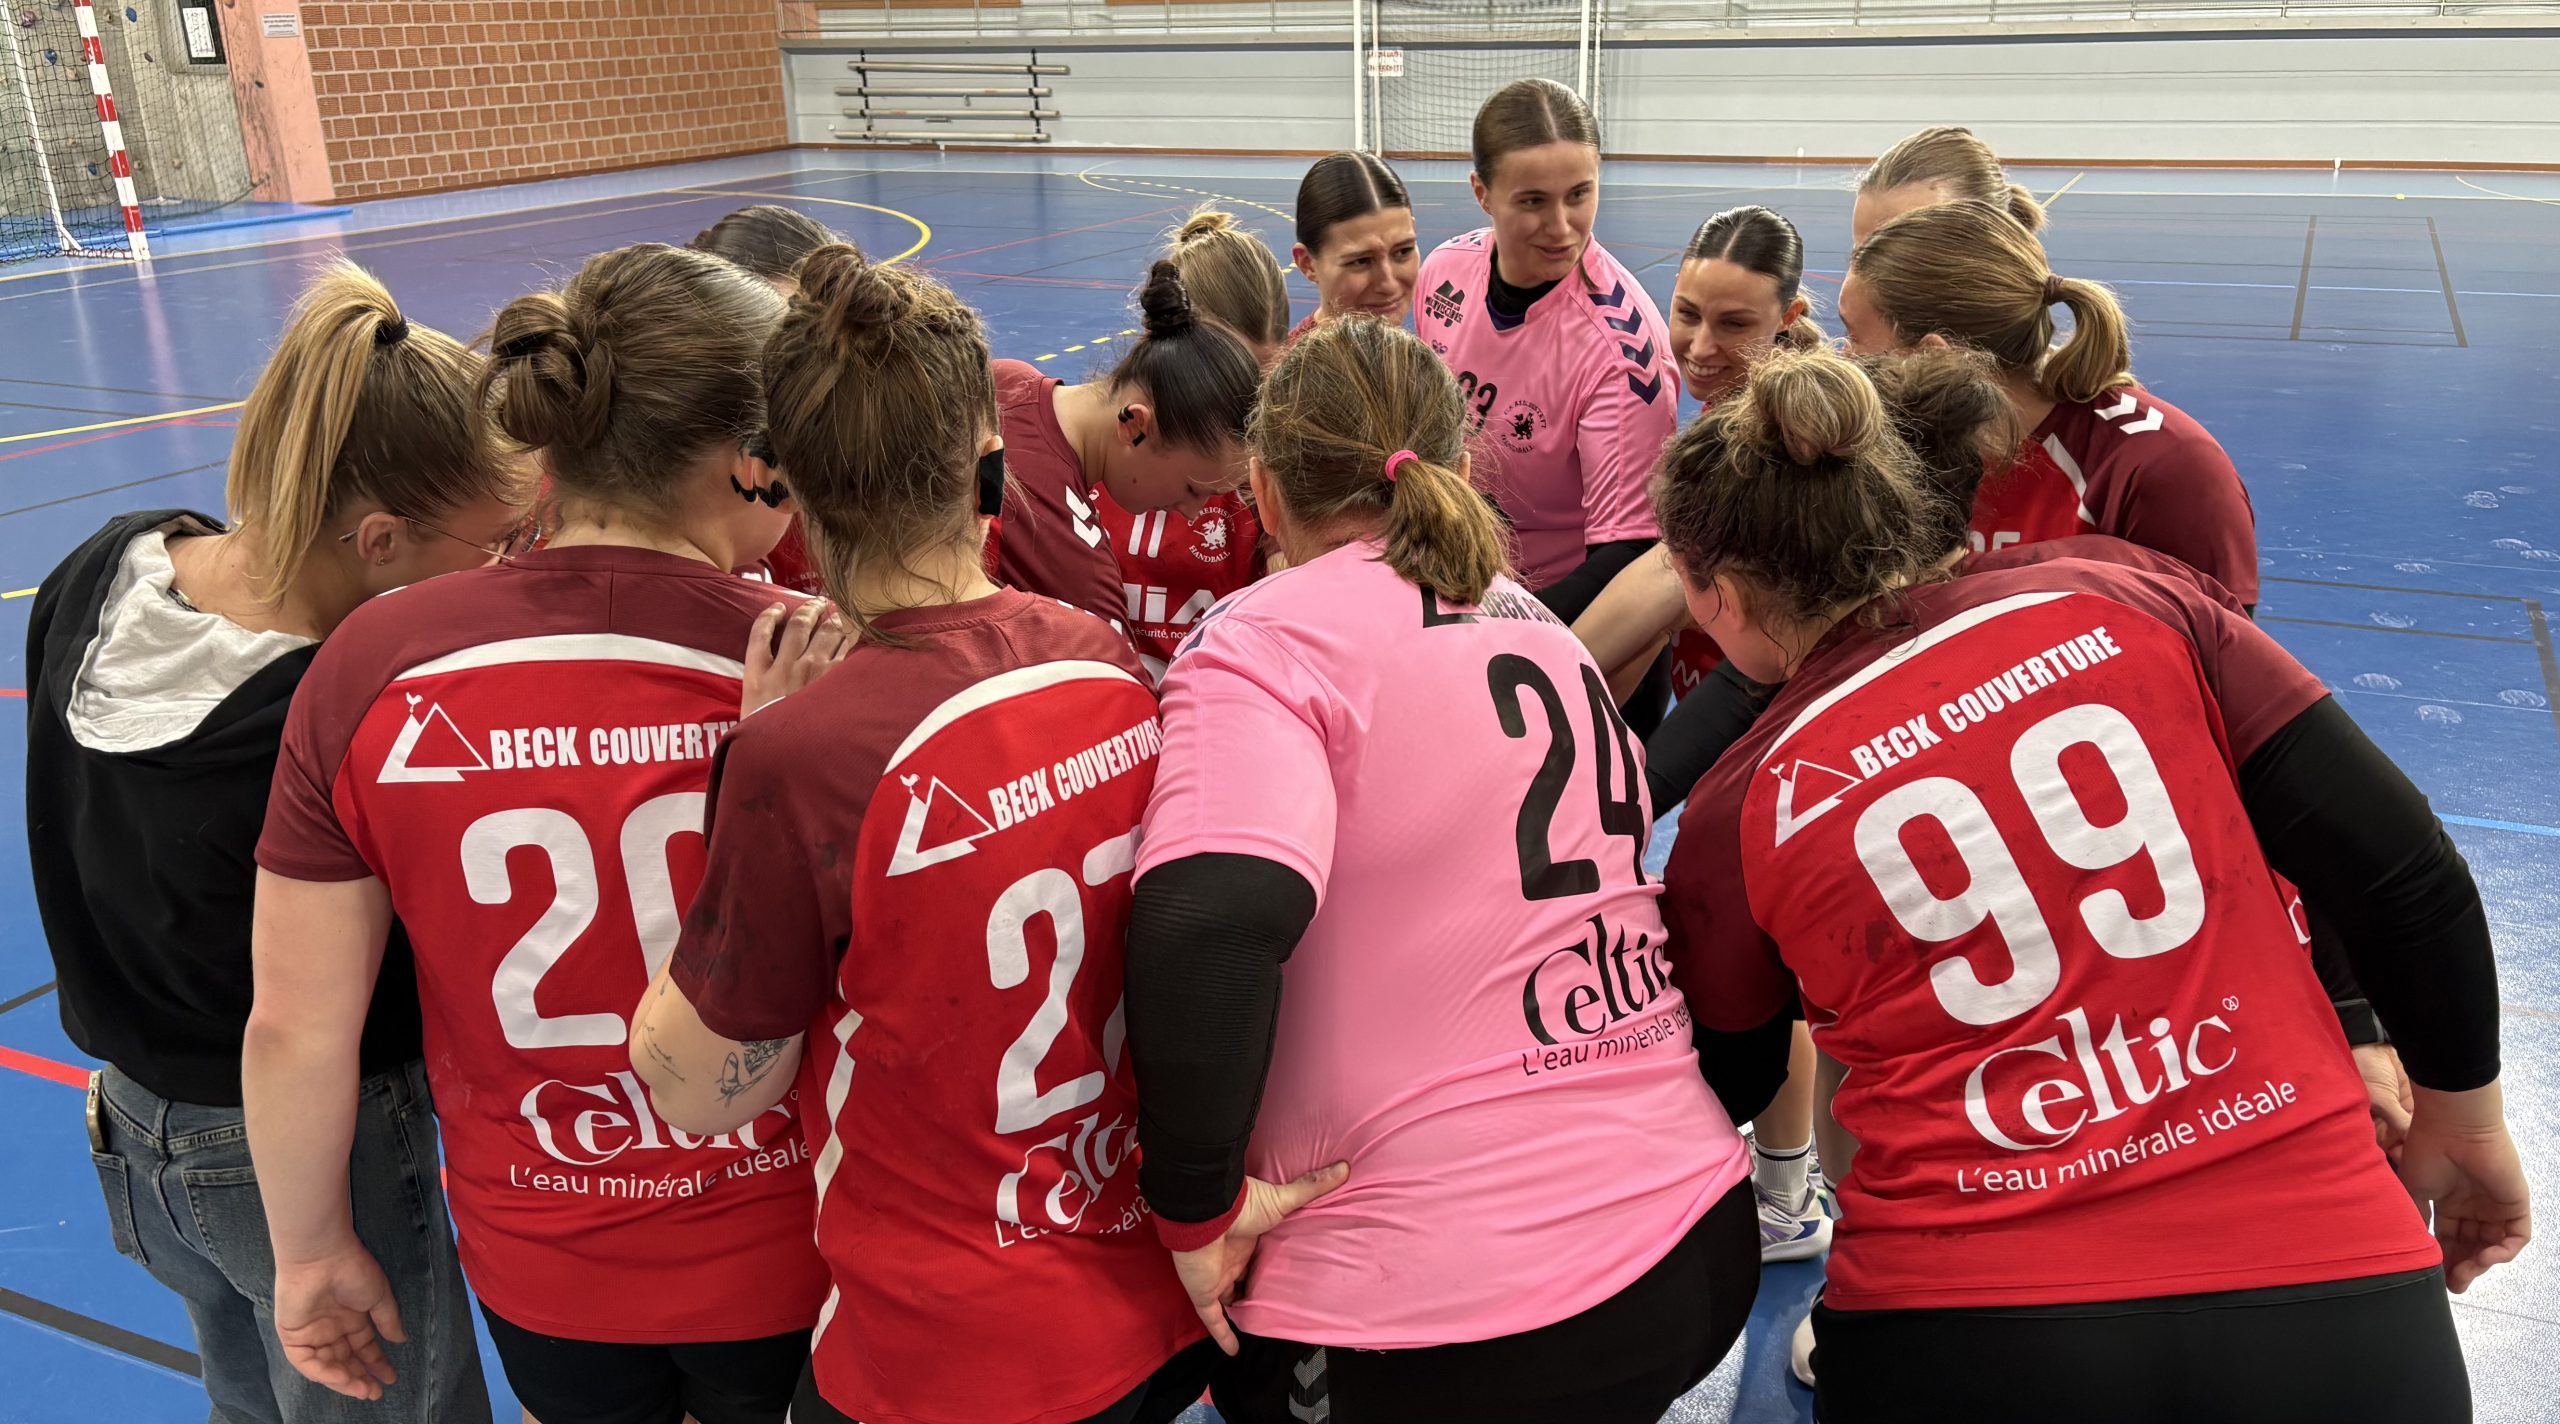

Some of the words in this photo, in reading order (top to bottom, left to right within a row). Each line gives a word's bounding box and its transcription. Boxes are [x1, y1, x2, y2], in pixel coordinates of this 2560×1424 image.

[1189, 545, 1231, 563] HANDBALL
[1483, 590, 1533, 621] BECK
[489, 726, 581, 770] BECK
[1849, 713, 1943, 780] BECK
[1939, 626, 2123, 734] COUVERTURE
[987, 766, 1056, 832] BECK
[1486, 652, 1648, 902] 24
[1853, 702, 2206, 1026] 99
[986, 823, 1142, 1136] 2
[1956, 1166, 2047, 1194] L'eau
[2056, 1118, 2198, 1185] minérale
[2196, 1078, 2297, 1136] idéale
[1963, 1006, 2238, 1152] Celtic
[510, 1163, 590, 1195] L'eau
